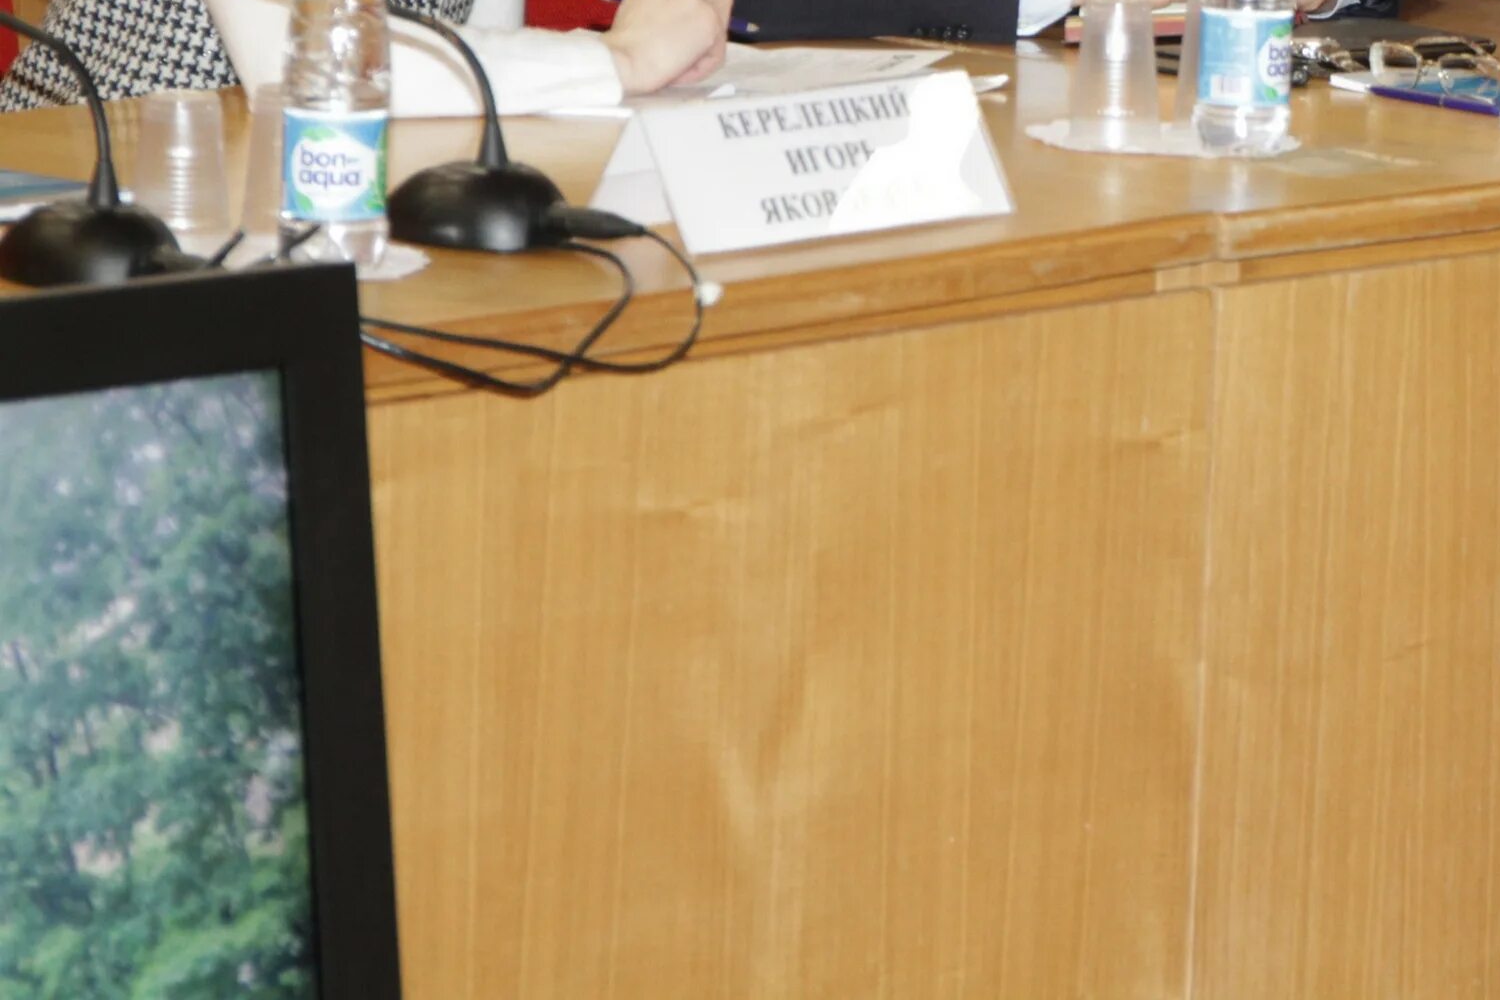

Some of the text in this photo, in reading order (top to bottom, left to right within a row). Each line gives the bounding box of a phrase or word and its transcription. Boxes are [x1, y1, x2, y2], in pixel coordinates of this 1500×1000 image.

[717, 86, 911, 139] КЕРЕЛЕЦКИЙ
[299, 170, 361, 190] aqua
[761, 187, 848, 225] ЯКОВ
